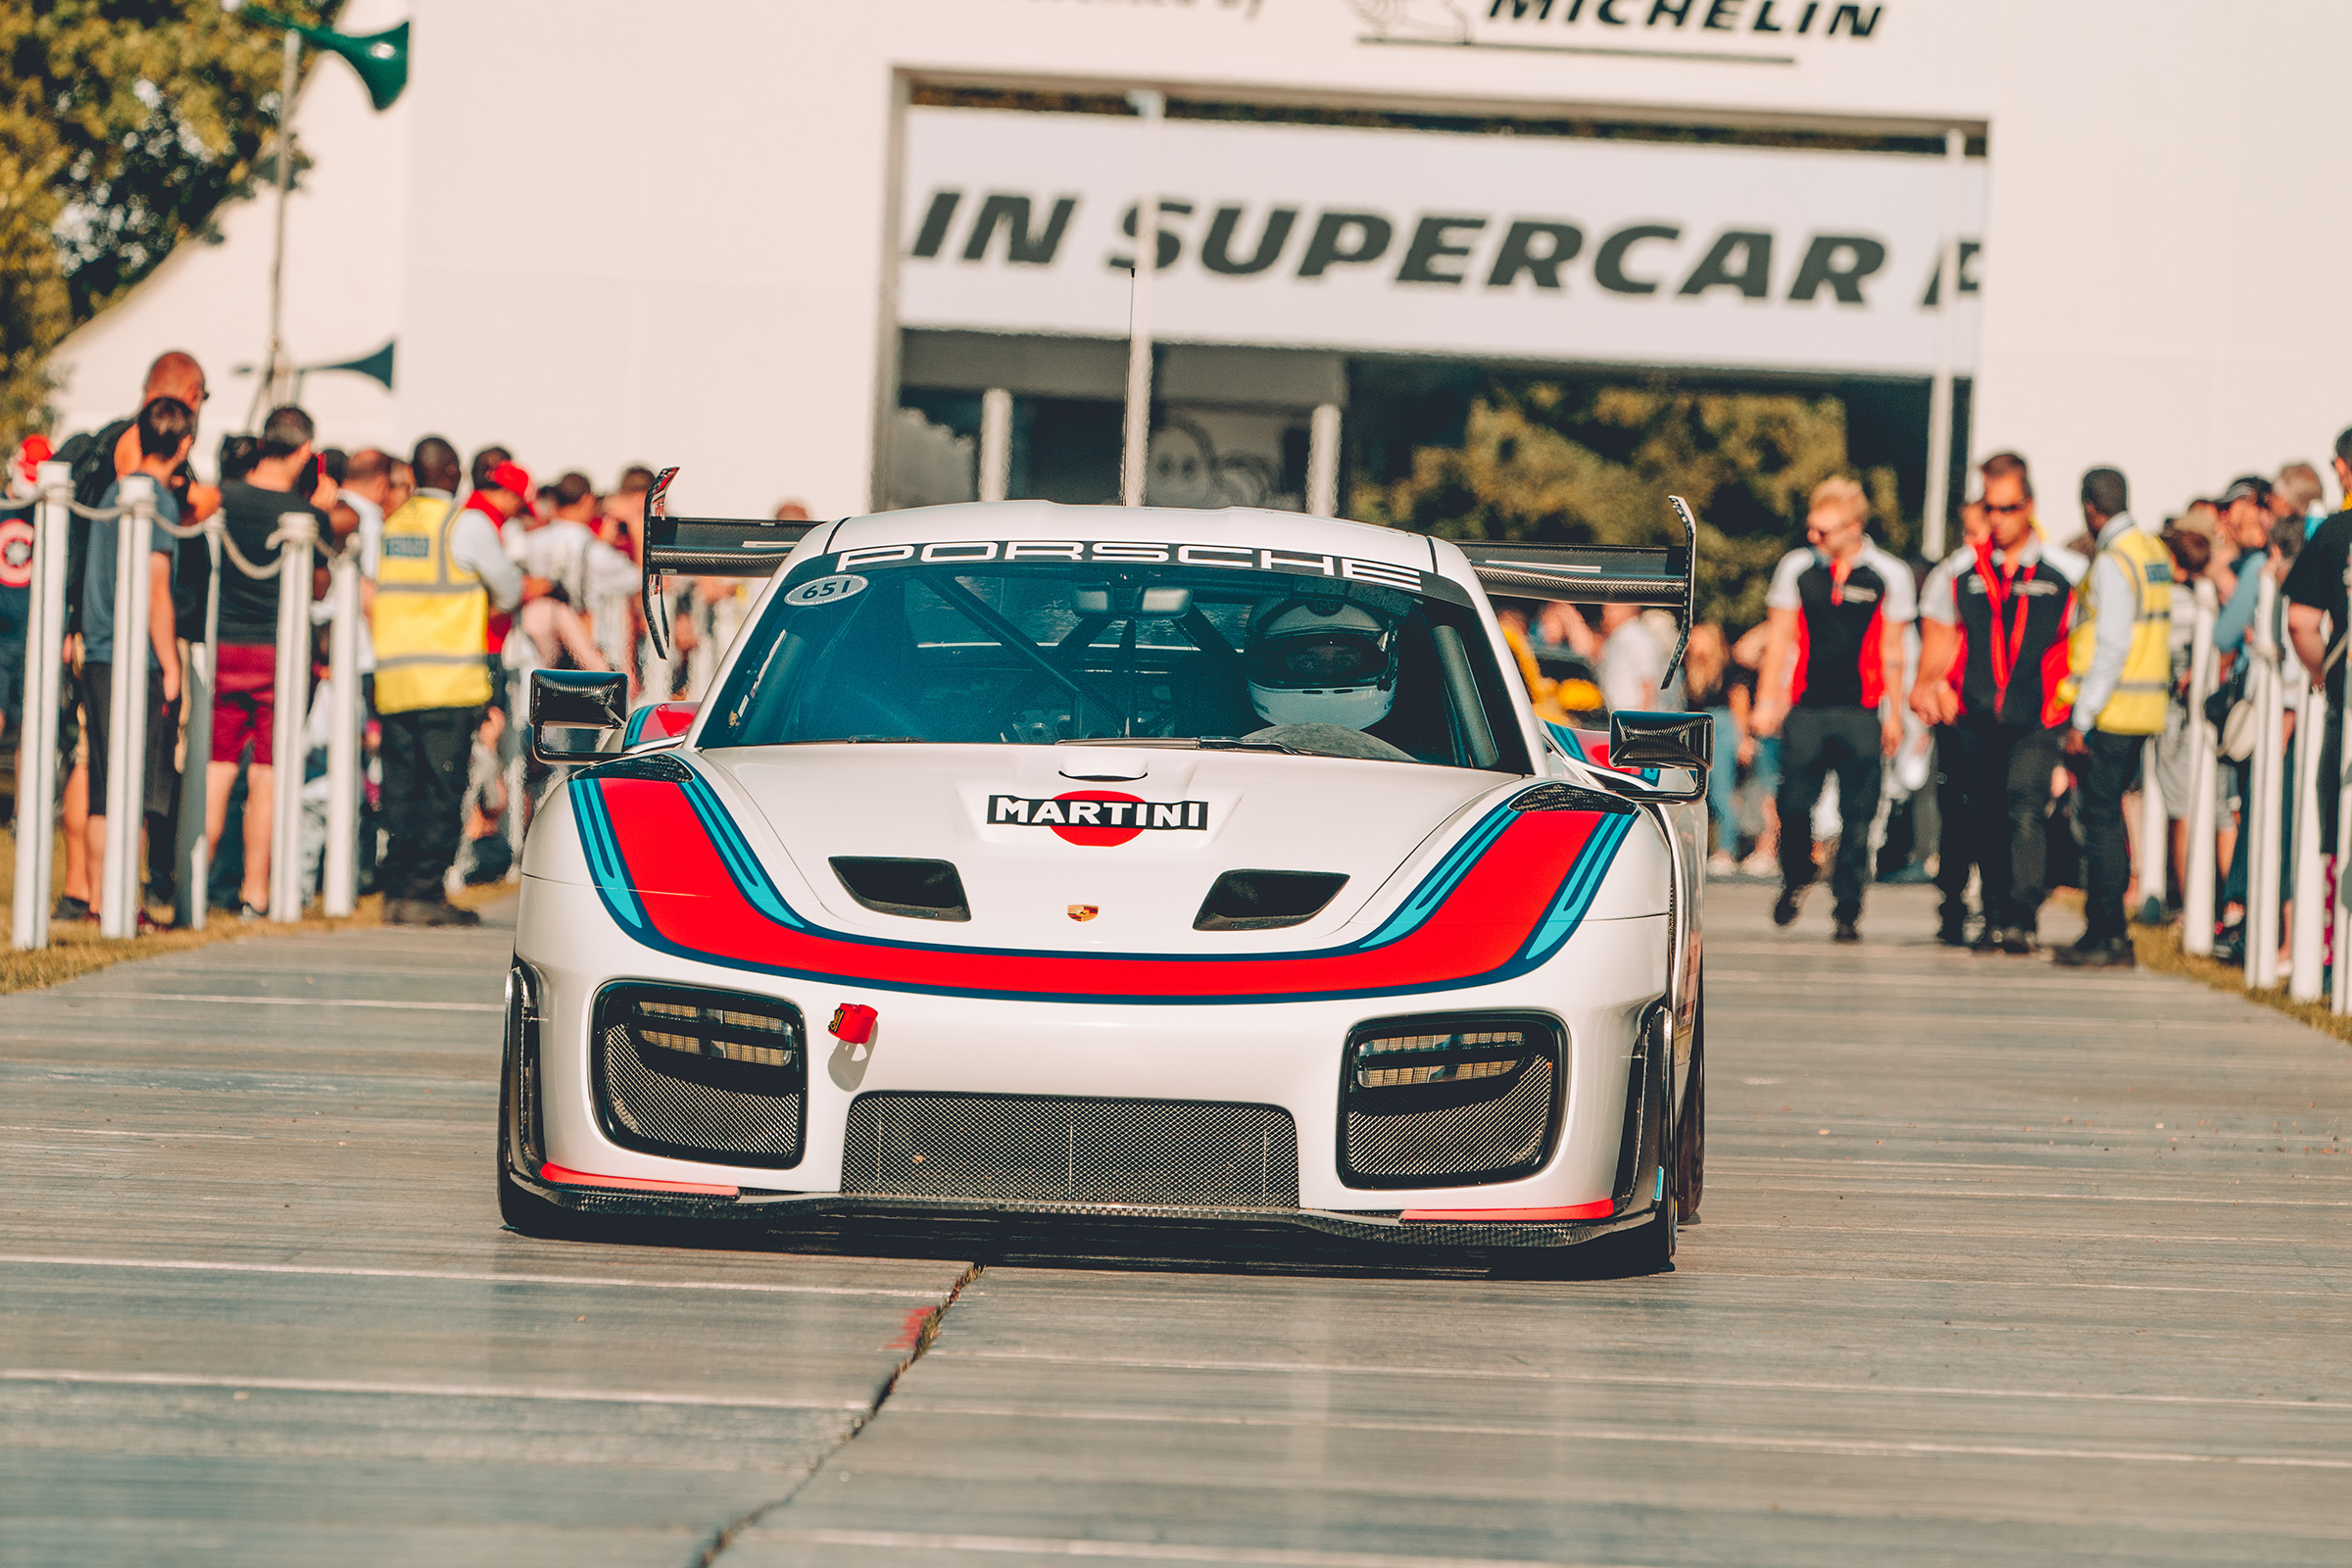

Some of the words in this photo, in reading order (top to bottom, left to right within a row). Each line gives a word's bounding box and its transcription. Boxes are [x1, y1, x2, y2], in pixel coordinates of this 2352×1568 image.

[1488, 0, 1882, 37] MICHELIN
[911, 192, 1077, 264] IN
[1108, 201, 1886, 304] SUPERCAR
[835, 541, 1423, 591] PORSCHE
[802, 579, 852, 600] 651
[995, 796, 1200, 827] MARTINI
